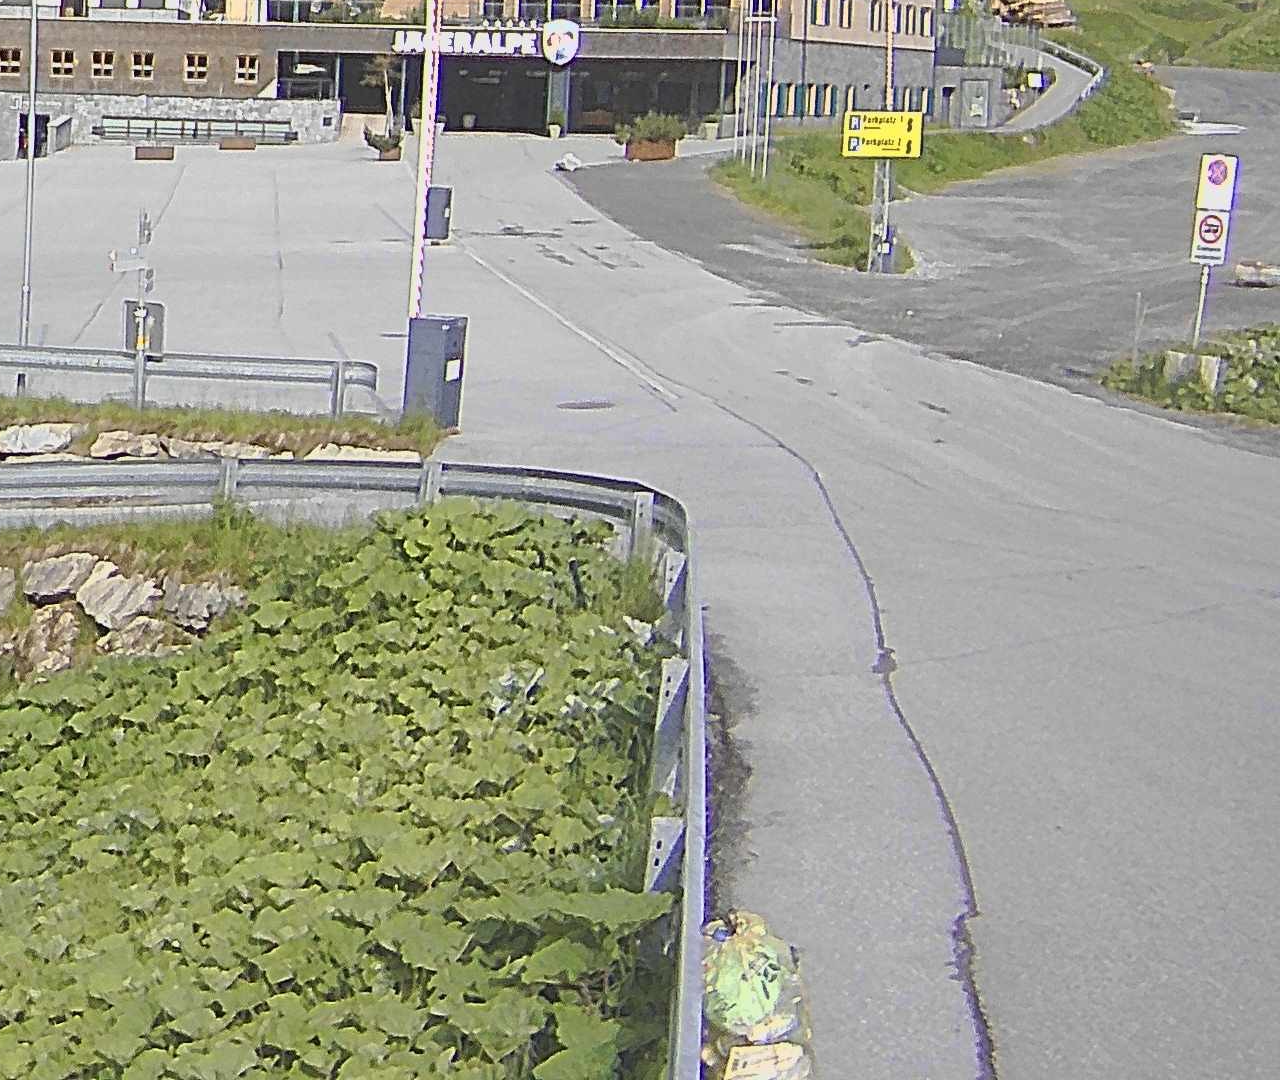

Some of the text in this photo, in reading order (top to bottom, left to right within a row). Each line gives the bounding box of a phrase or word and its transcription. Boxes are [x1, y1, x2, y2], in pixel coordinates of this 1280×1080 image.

[391, 30, 538, 55] JÄERALPE
[863, 114, 896, 125] Parkplatz
[861, 137, 894, 147] Parkplatz
